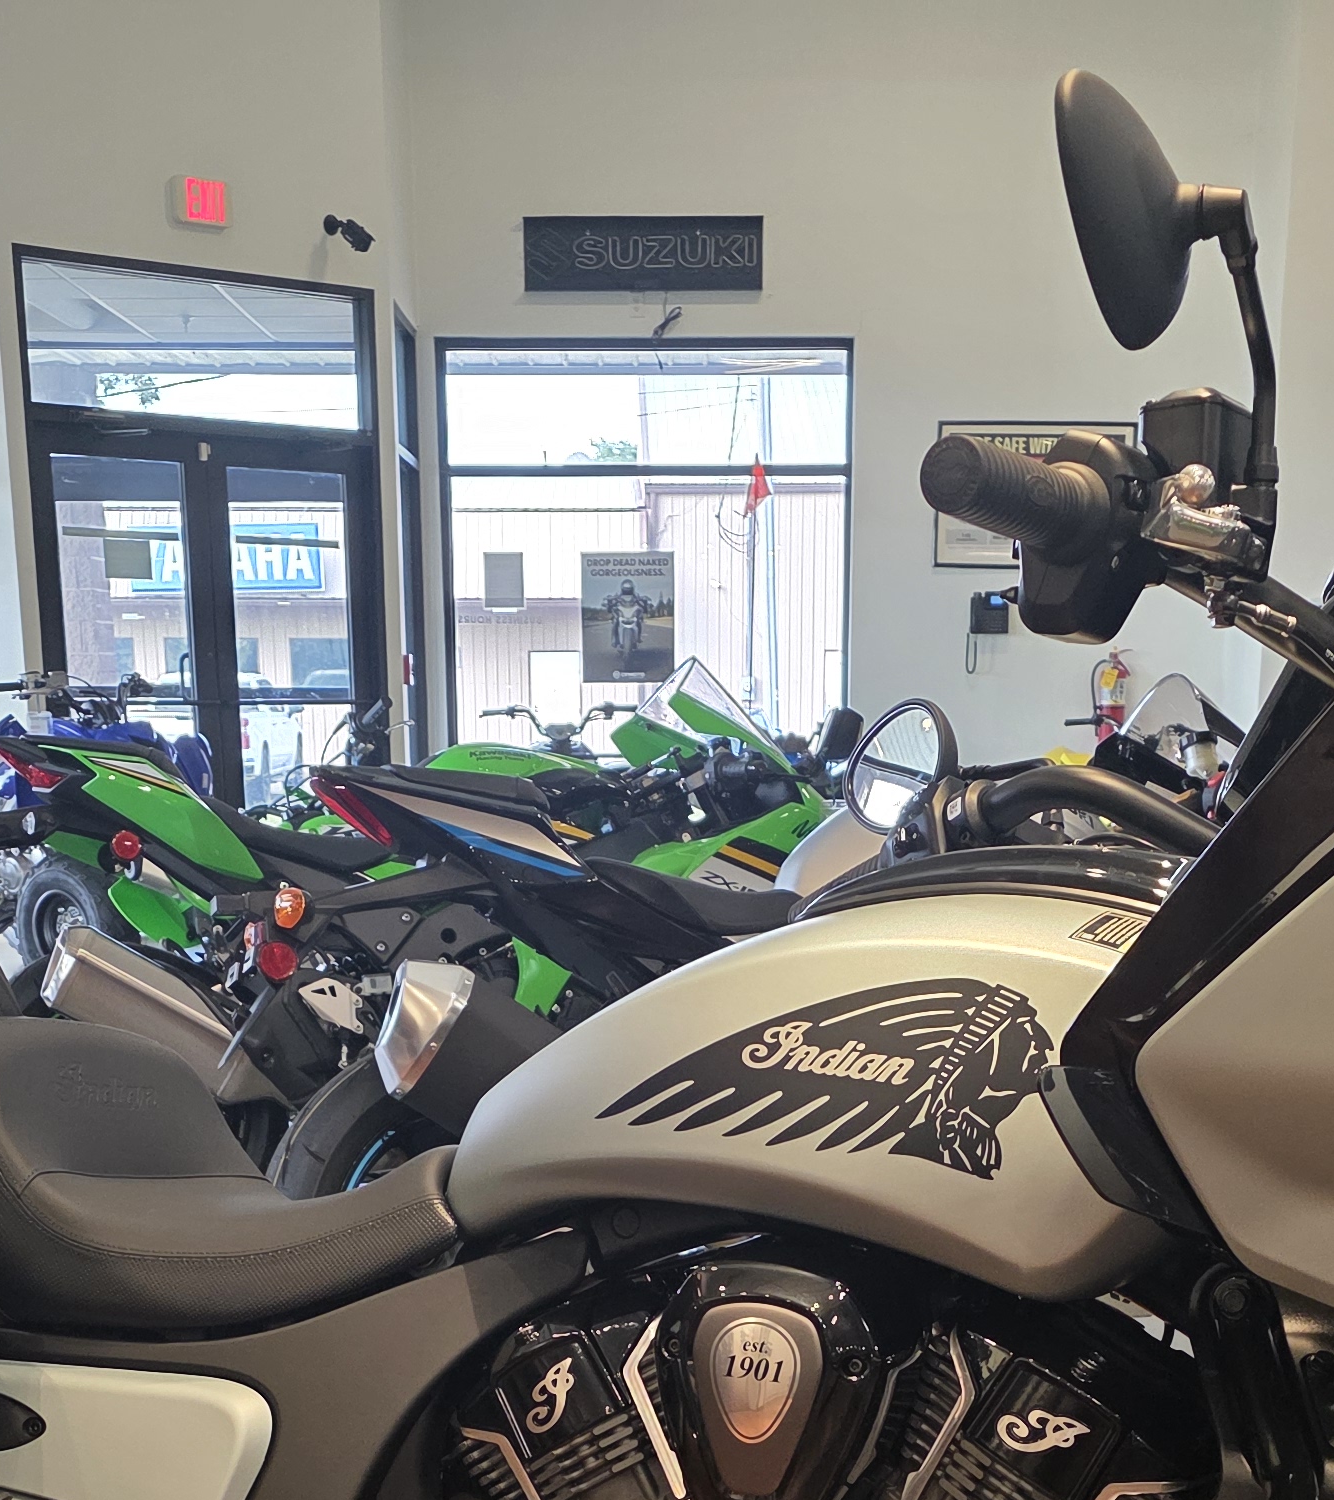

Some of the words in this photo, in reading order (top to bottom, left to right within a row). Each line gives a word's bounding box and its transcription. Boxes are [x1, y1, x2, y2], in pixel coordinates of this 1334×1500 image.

[185, 177, 226, 223] EXIT
[572, 235, 758, 269] SUZUKI
[994, 436, 1027, 454] SAFE
[1028, 437, 1062, 454] WIT
[586, 558, 611, 567] DROP
[612, 558, 637, 567] DEAD
[638, 558, 669, 567] NAKED
[741, 1021, 915, 1086] Indian
[742, 1340, 769, 1354] est.
[724, 1355, 784, 1384] 1901
